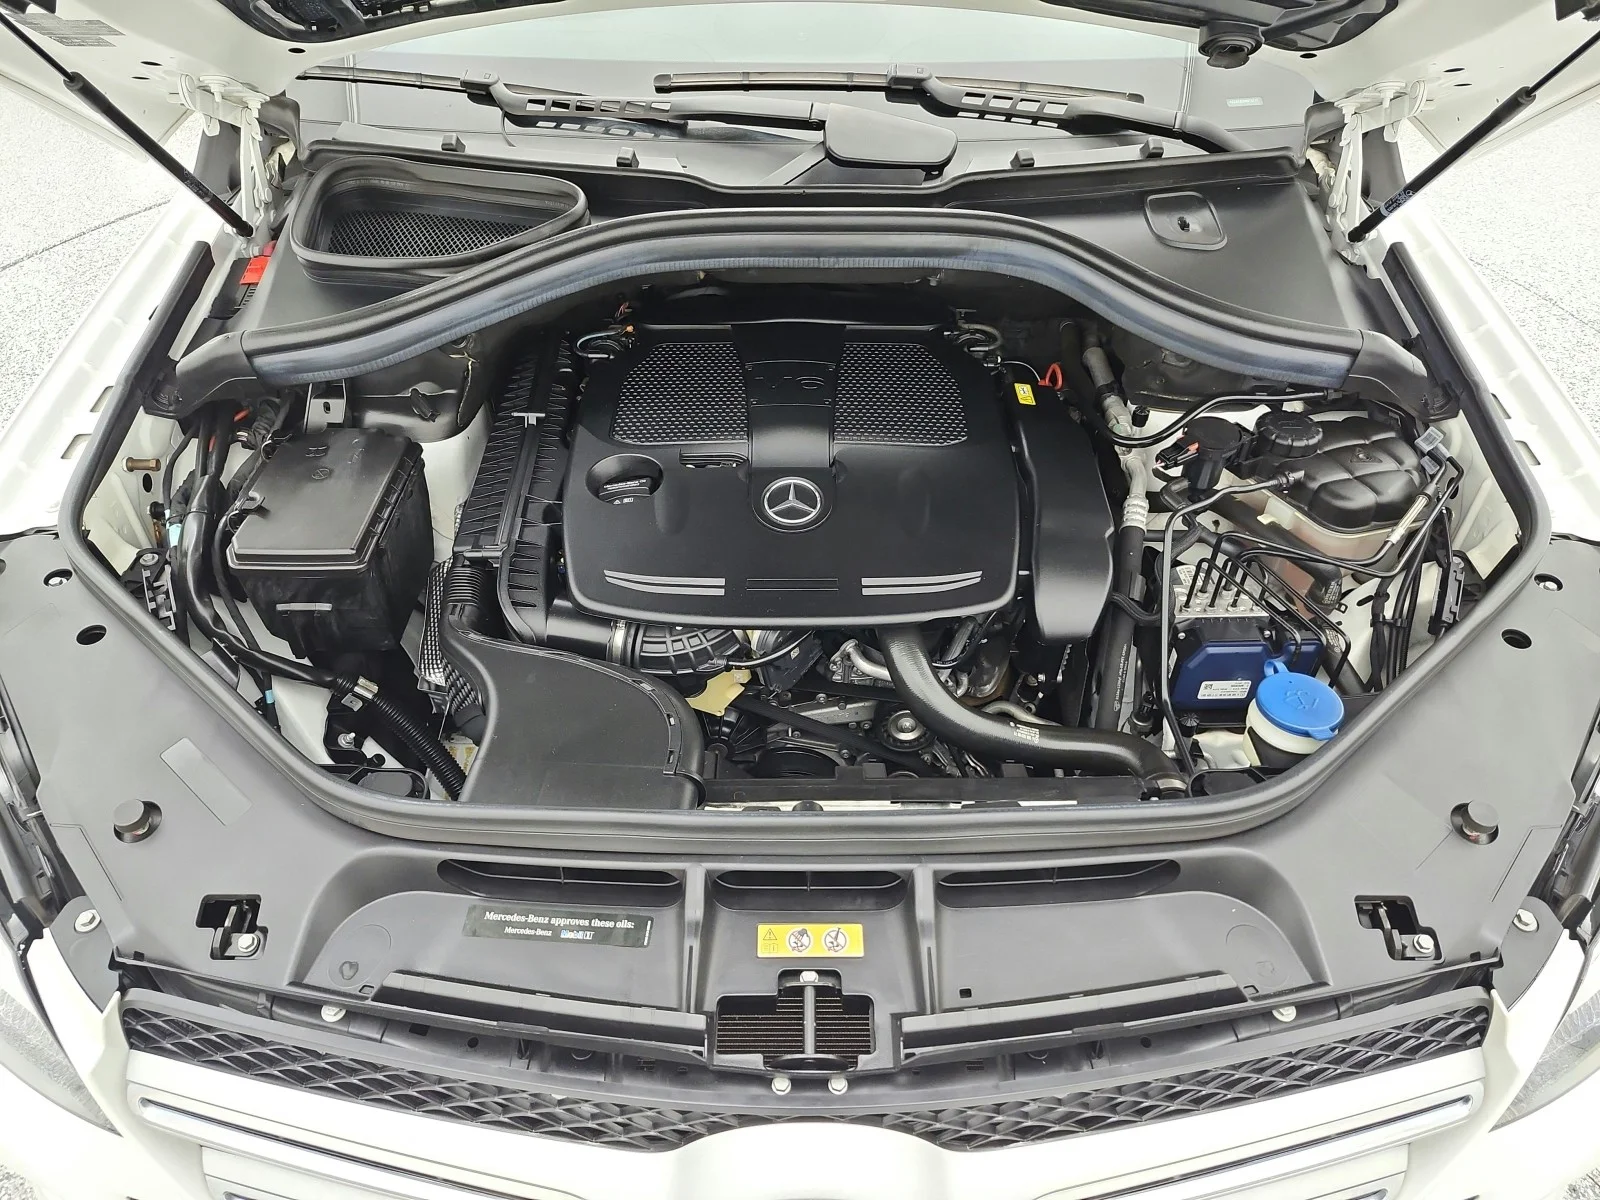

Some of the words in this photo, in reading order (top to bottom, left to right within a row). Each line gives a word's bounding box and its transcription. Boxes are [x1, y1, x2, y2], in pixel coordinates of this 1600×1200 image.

[484, 911, 549, 924] Mercedes-Benz
[550, 916, 590, 926] approves
[591, 918, 615, 928] these
[504, 926, 552, 936] Mercedes-Benz
